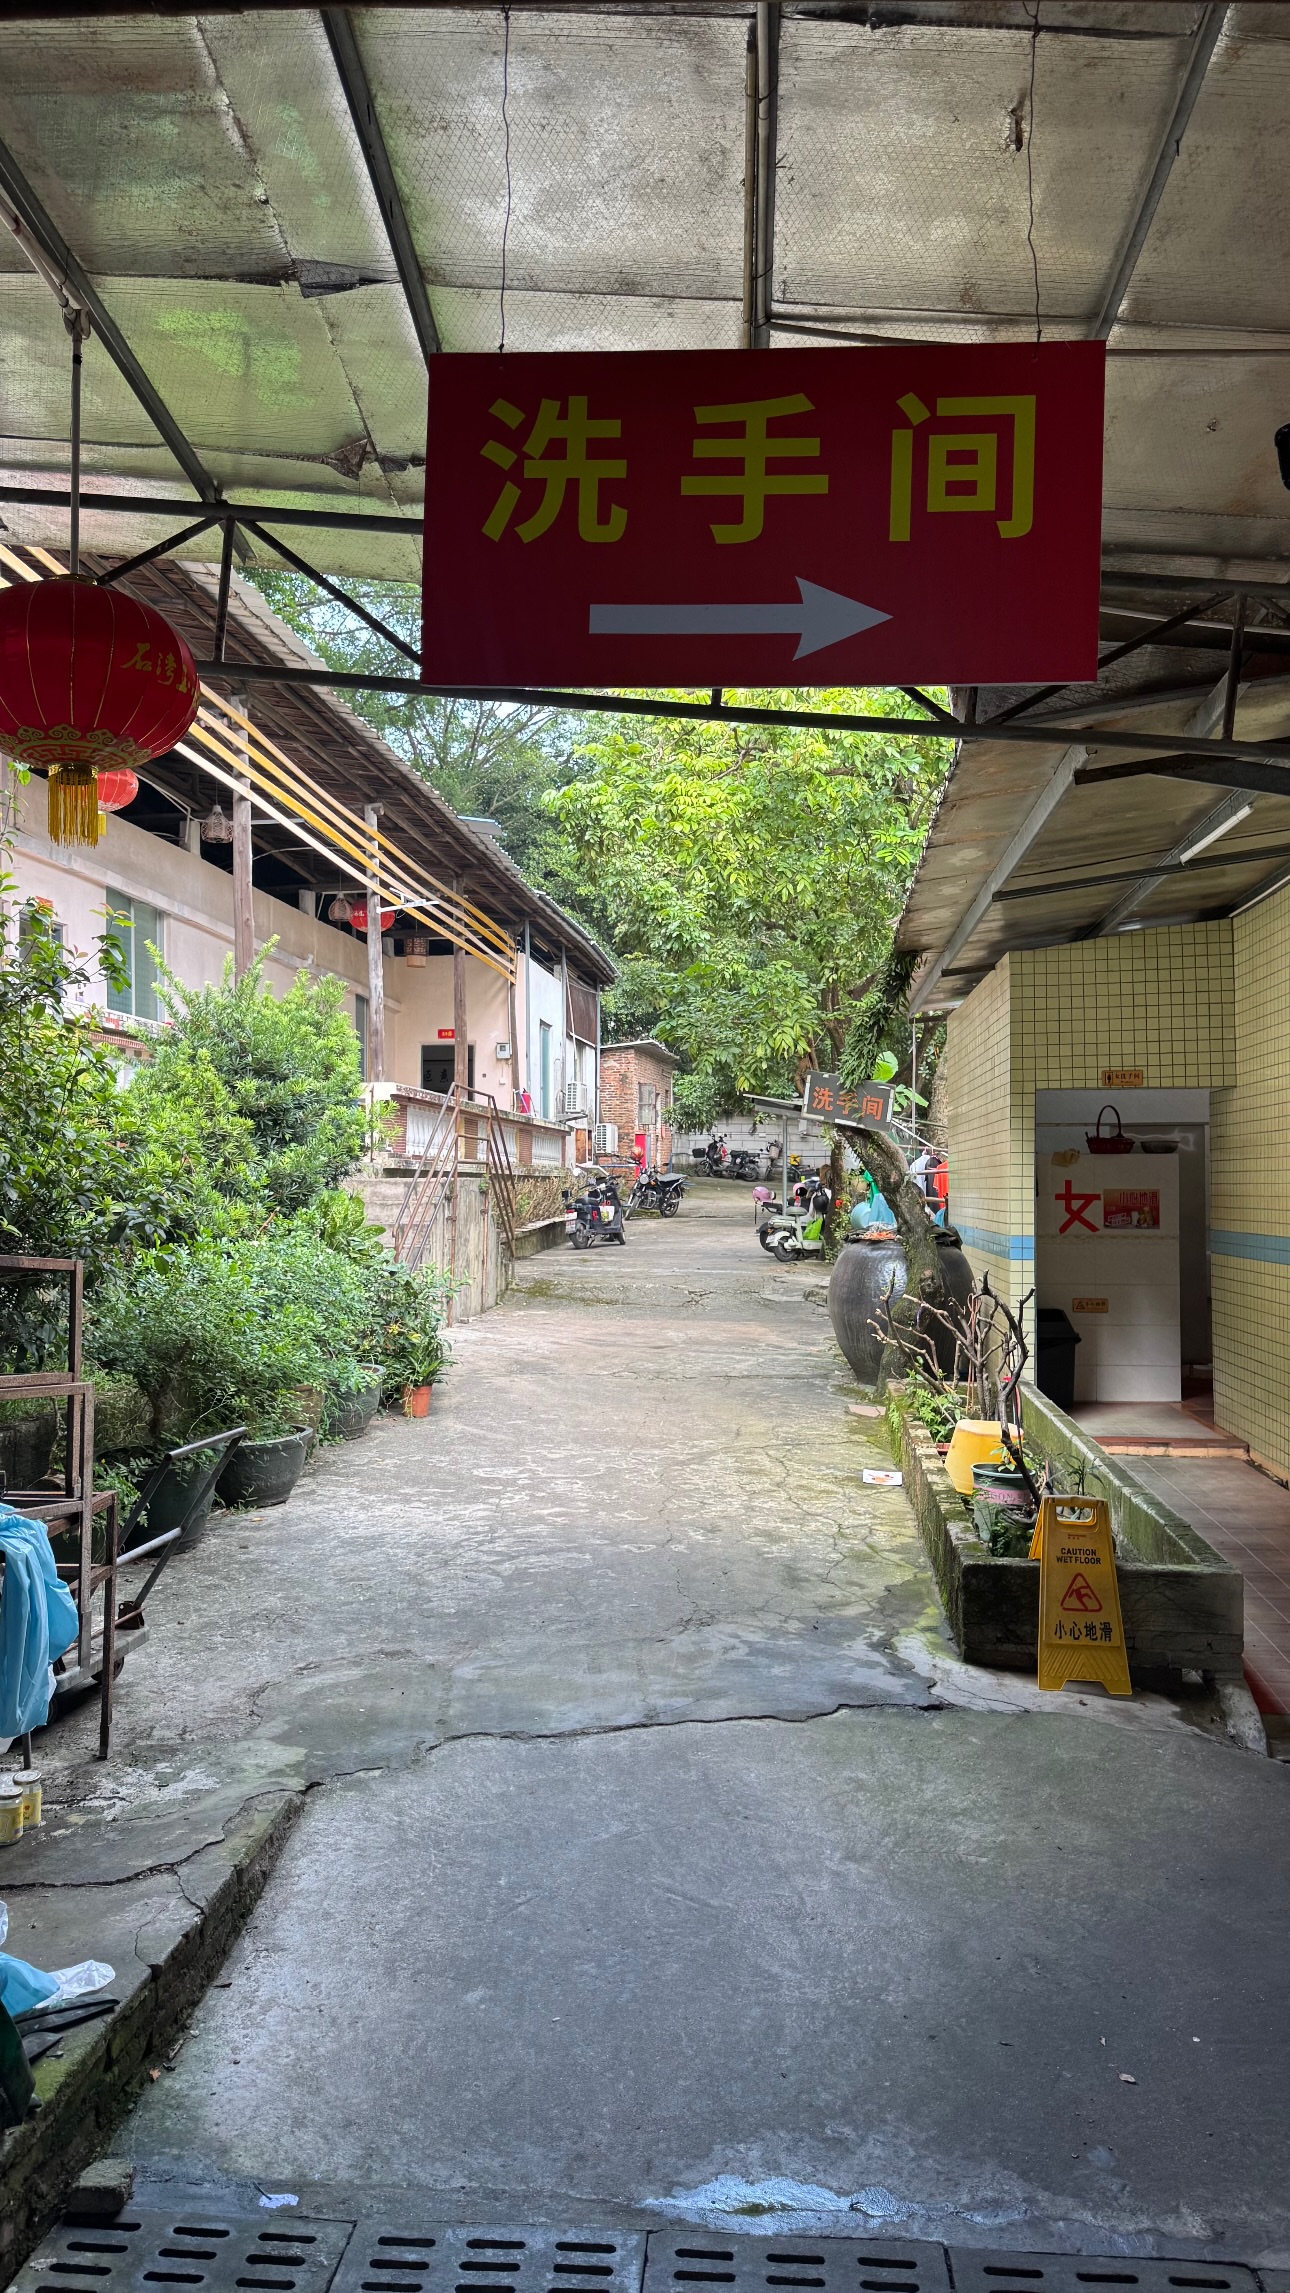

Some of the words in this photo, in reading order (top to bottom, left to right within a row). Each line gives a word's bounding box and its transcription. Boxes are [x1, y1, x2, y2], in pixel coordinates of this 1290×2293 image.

[479, 392, 1037, 545] 洗手间
[812, 1086, 884, 1121] 洗手间
[1055, 1179, 1102, 1234] 女
[1056, 1555, 1073, 1563] WET
[1074, 1557, 1101, 1565] FLOOR
[1060, 1547, 1097, 1556] CAUTION
[1054, 1619, 1113, 1642] 小心地滑
